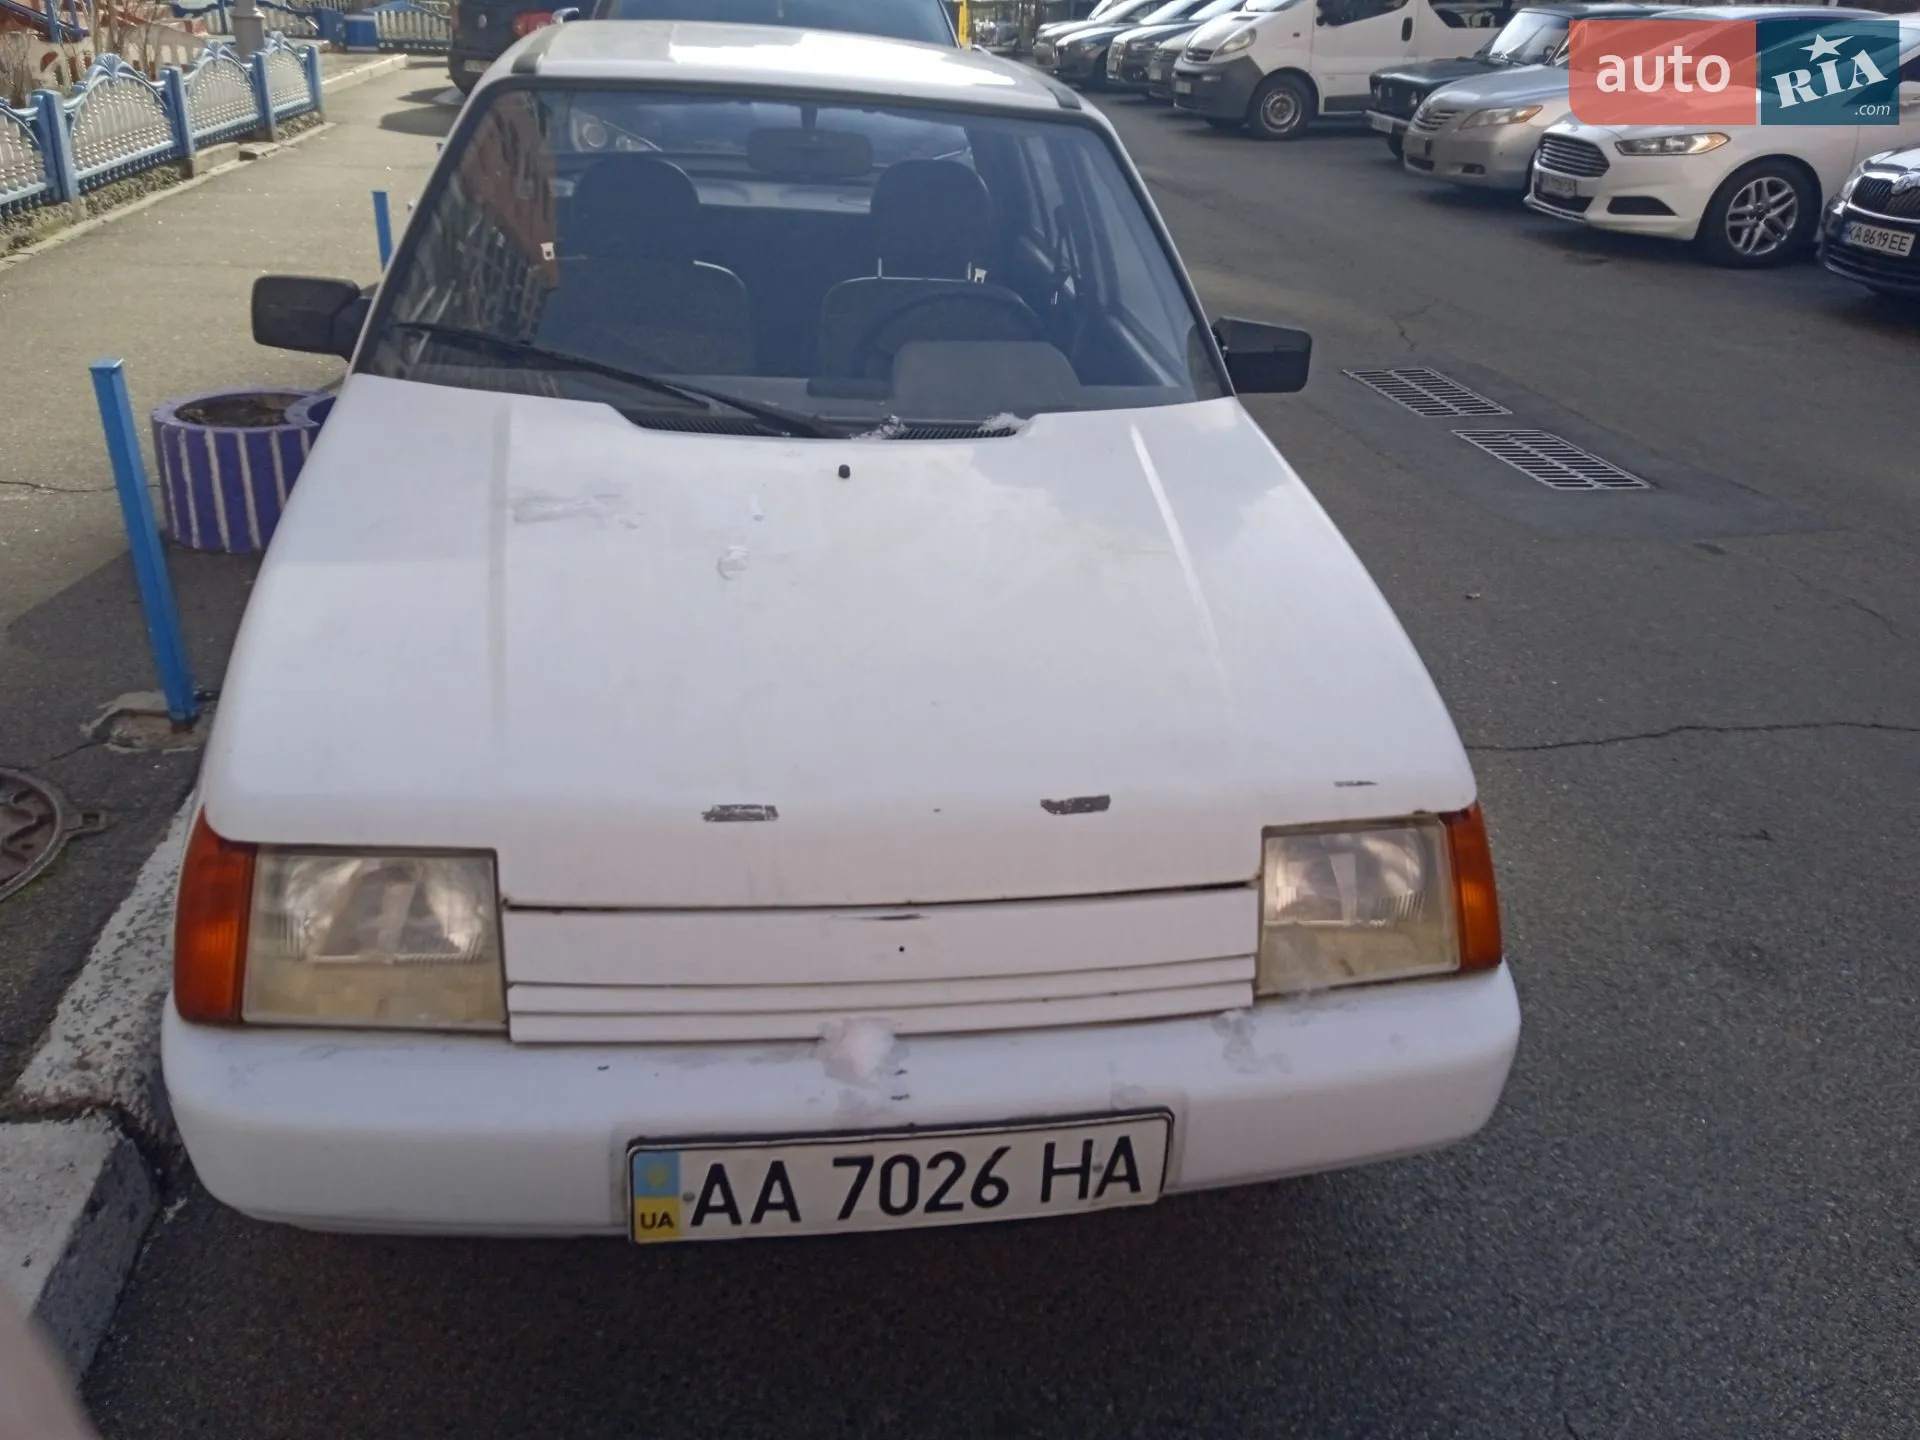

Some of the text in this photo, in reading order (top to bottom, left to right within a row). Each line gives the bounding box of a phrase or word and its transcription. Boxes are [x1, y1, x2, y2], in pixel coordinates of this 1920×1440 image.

[1862, 228, 1889, 248] 8619
[1888, 234, 1910, 252] EE
[690, 1135, 1143, 1226] AA 7026 HA
[639, 1211, 675, 1230] UA
